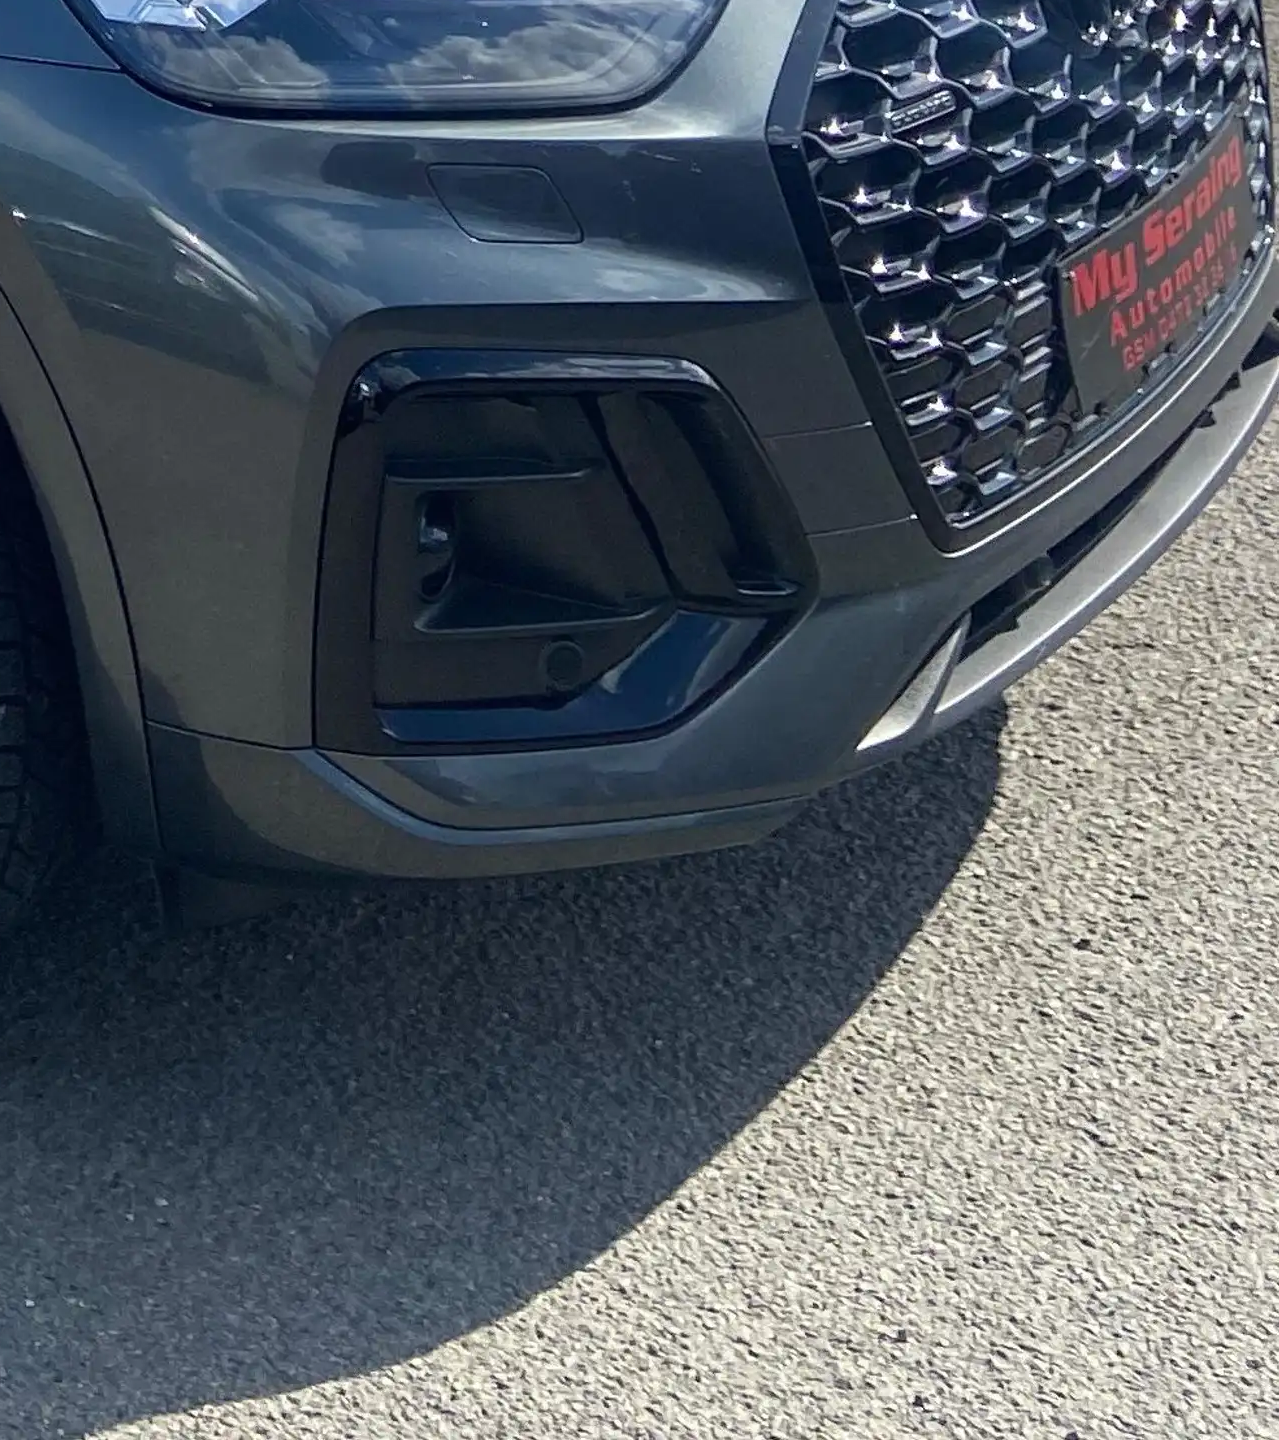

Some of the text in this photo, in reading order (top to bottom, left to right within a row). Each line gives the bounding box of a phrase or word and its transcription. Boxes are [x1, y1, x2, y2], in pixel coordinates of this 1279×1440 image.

[1071, 135, 1241, 317] My Seraing
[1110, 206, 1238, 348] Automobile
